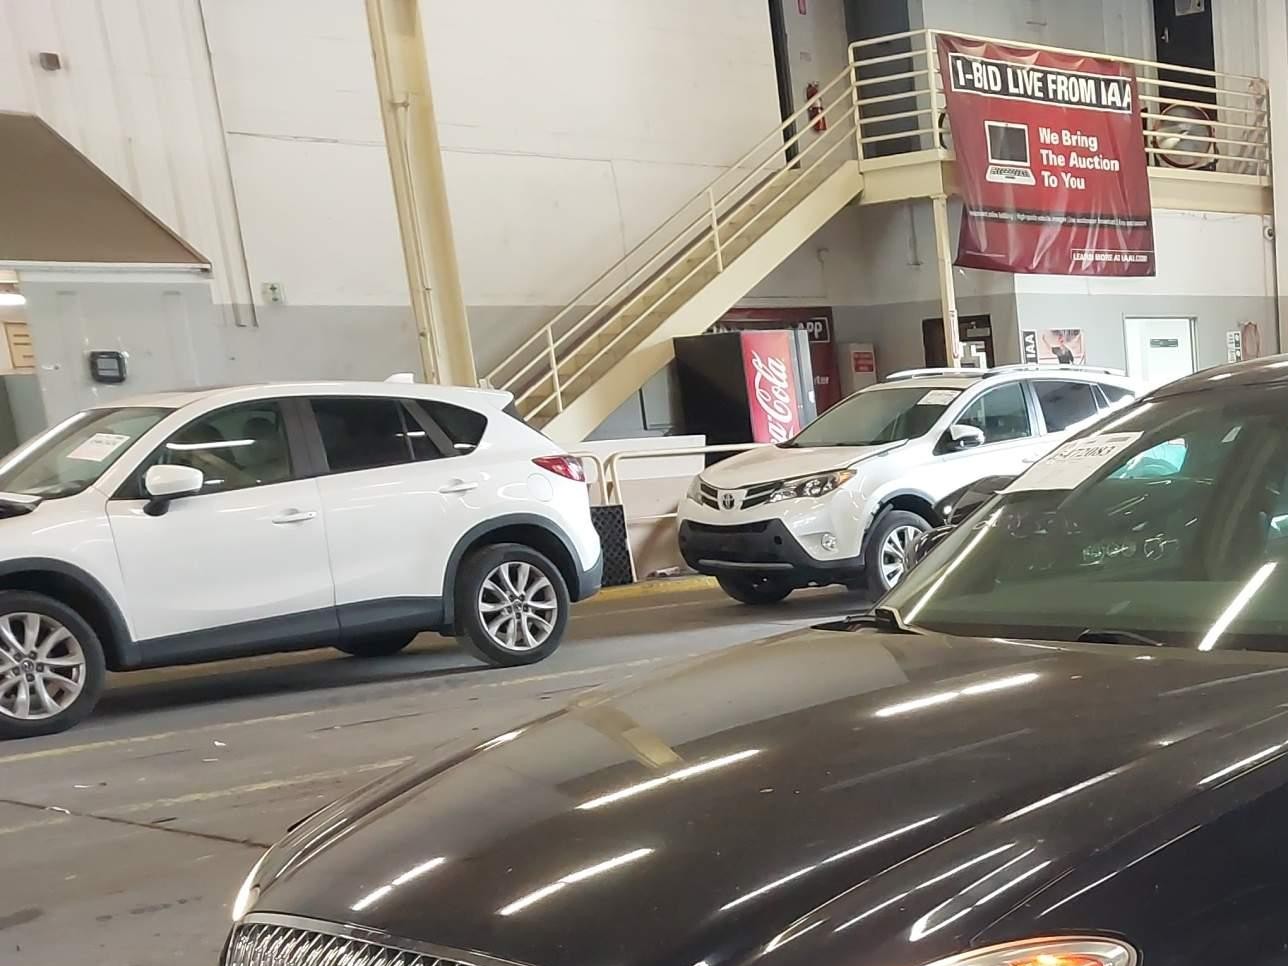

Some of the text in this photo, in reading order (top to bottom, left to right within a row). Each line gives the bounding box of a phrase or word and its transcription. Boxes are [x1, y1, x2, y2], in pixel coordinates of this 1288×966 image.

[1007, 67, 1044, 98] LIVE
[1047, 74, 1097, 104] FROM
[1100, 81, 1132, 107] IAA
[1039, 128, 1098, 152] We Bring
[1040, 149, 1120, 171] The Auction
[1041, 171, 1085, 189] To You
[1024, 334, 1037, 358] IAA
